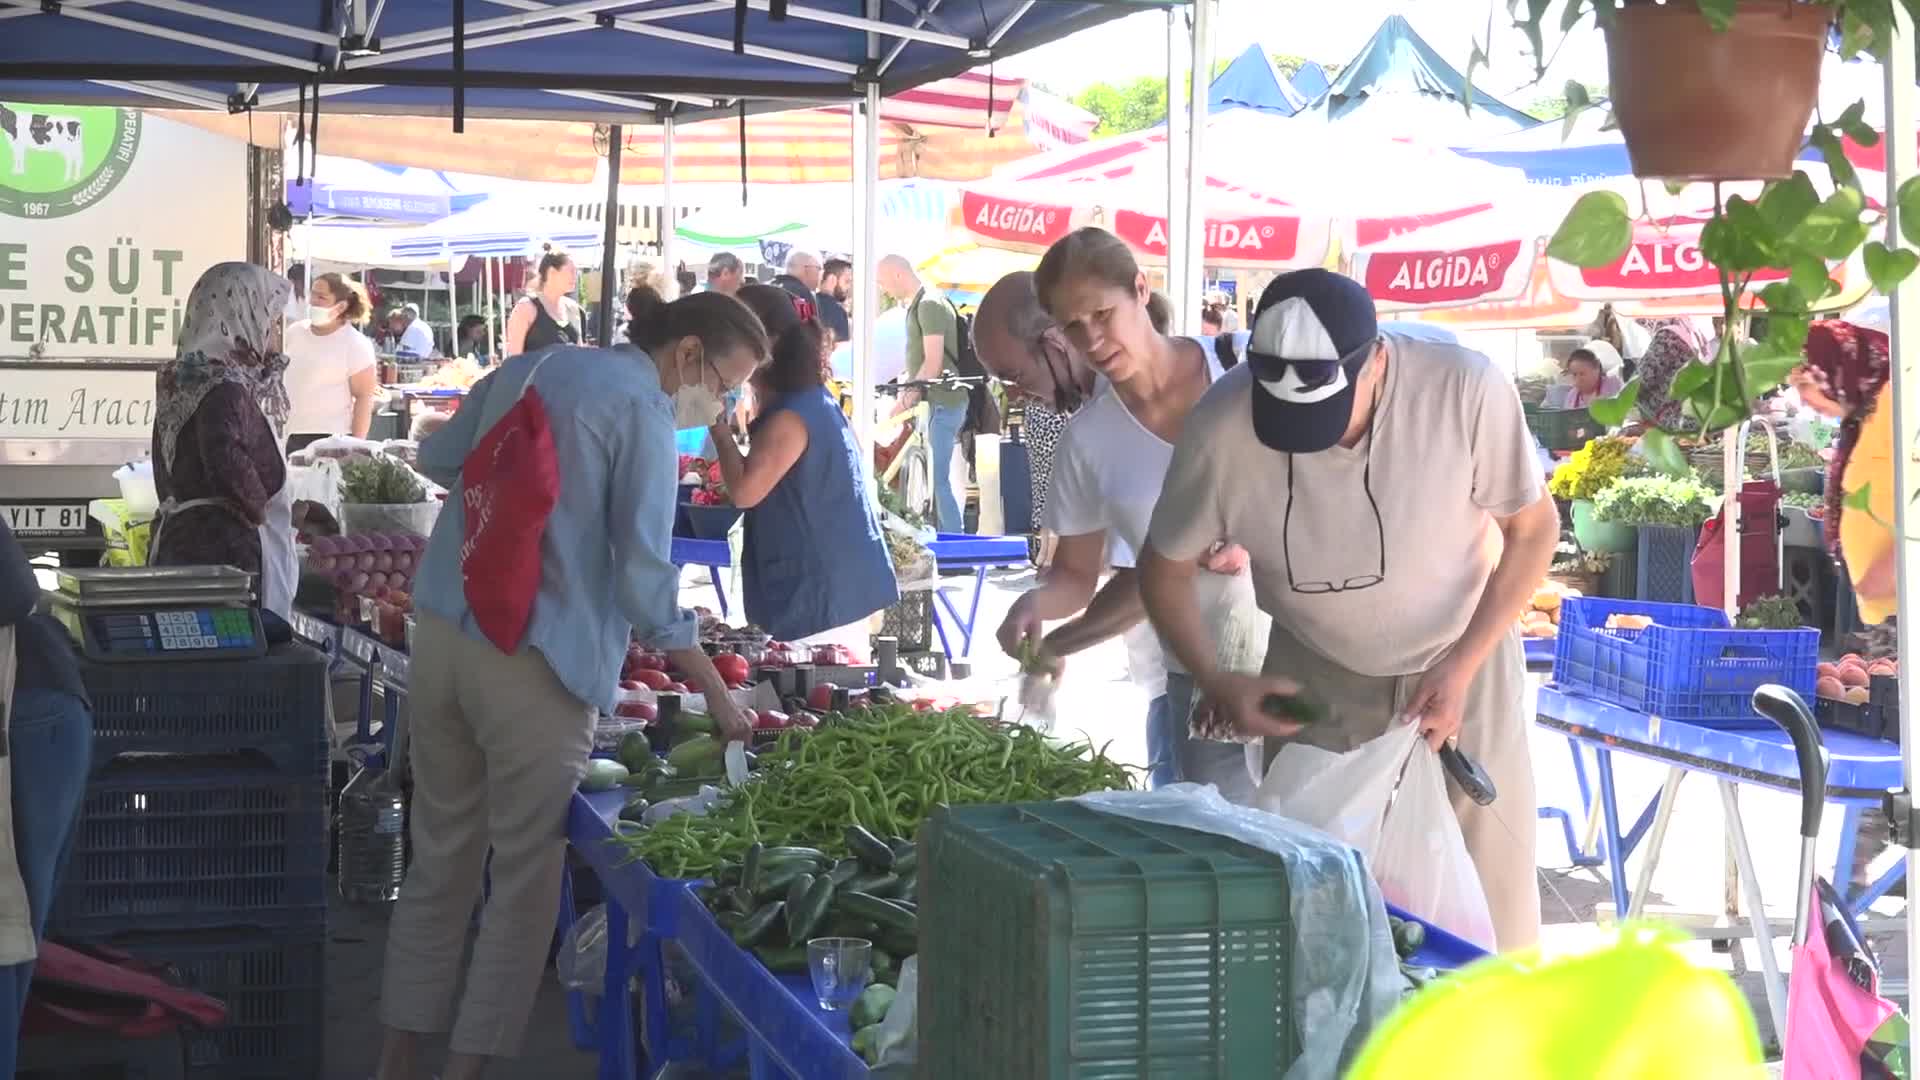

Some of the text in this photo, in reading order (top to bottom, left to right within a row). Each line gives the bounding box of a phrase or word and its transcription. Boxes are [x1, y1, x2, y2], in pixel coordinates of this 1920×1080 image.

[23, 202, 50, 216] 1967
[64, 237, 184, 296] SÜT
[58, 387, 153, 431] Aracı
[60, 508, 82, 528] 81
